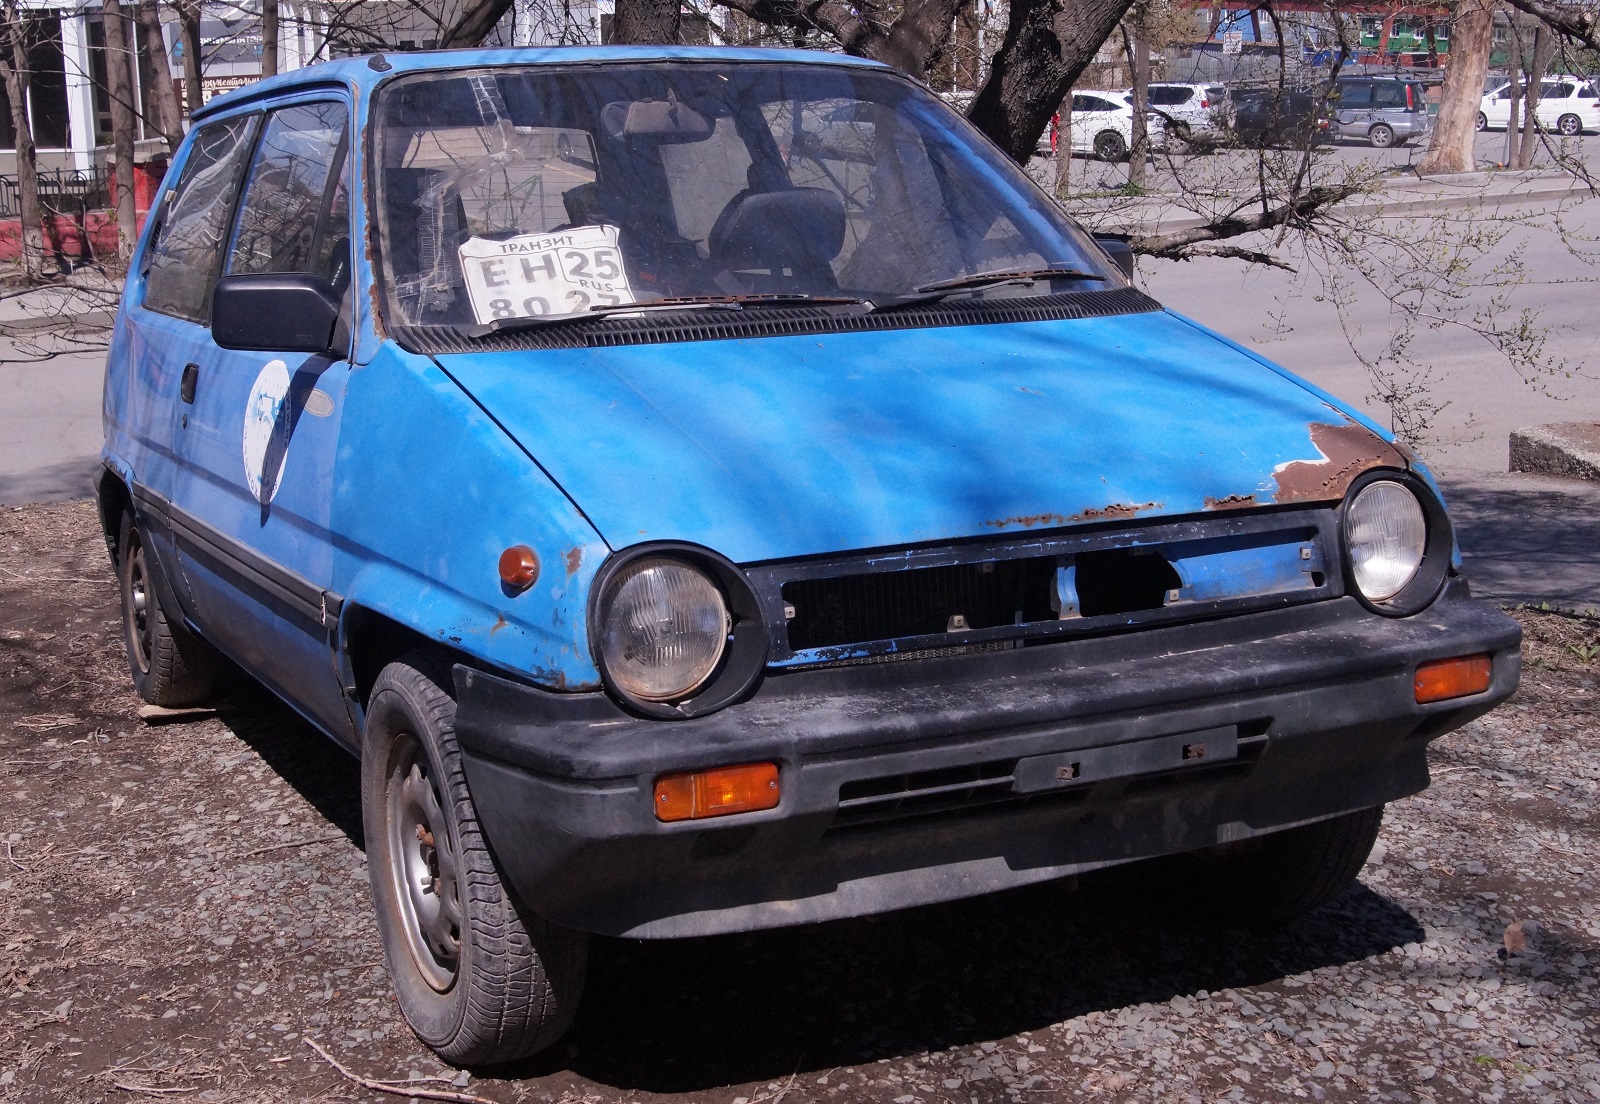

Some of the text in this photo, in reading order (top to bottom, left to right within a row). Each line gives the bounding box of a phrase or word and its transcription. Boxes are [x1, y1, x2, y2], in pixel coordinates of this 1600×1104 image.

[499, 236, 574, 254] ТРАНЗИТ
[564, 251, 620, 281] 25
[579, 279, 614, 292] RUS
